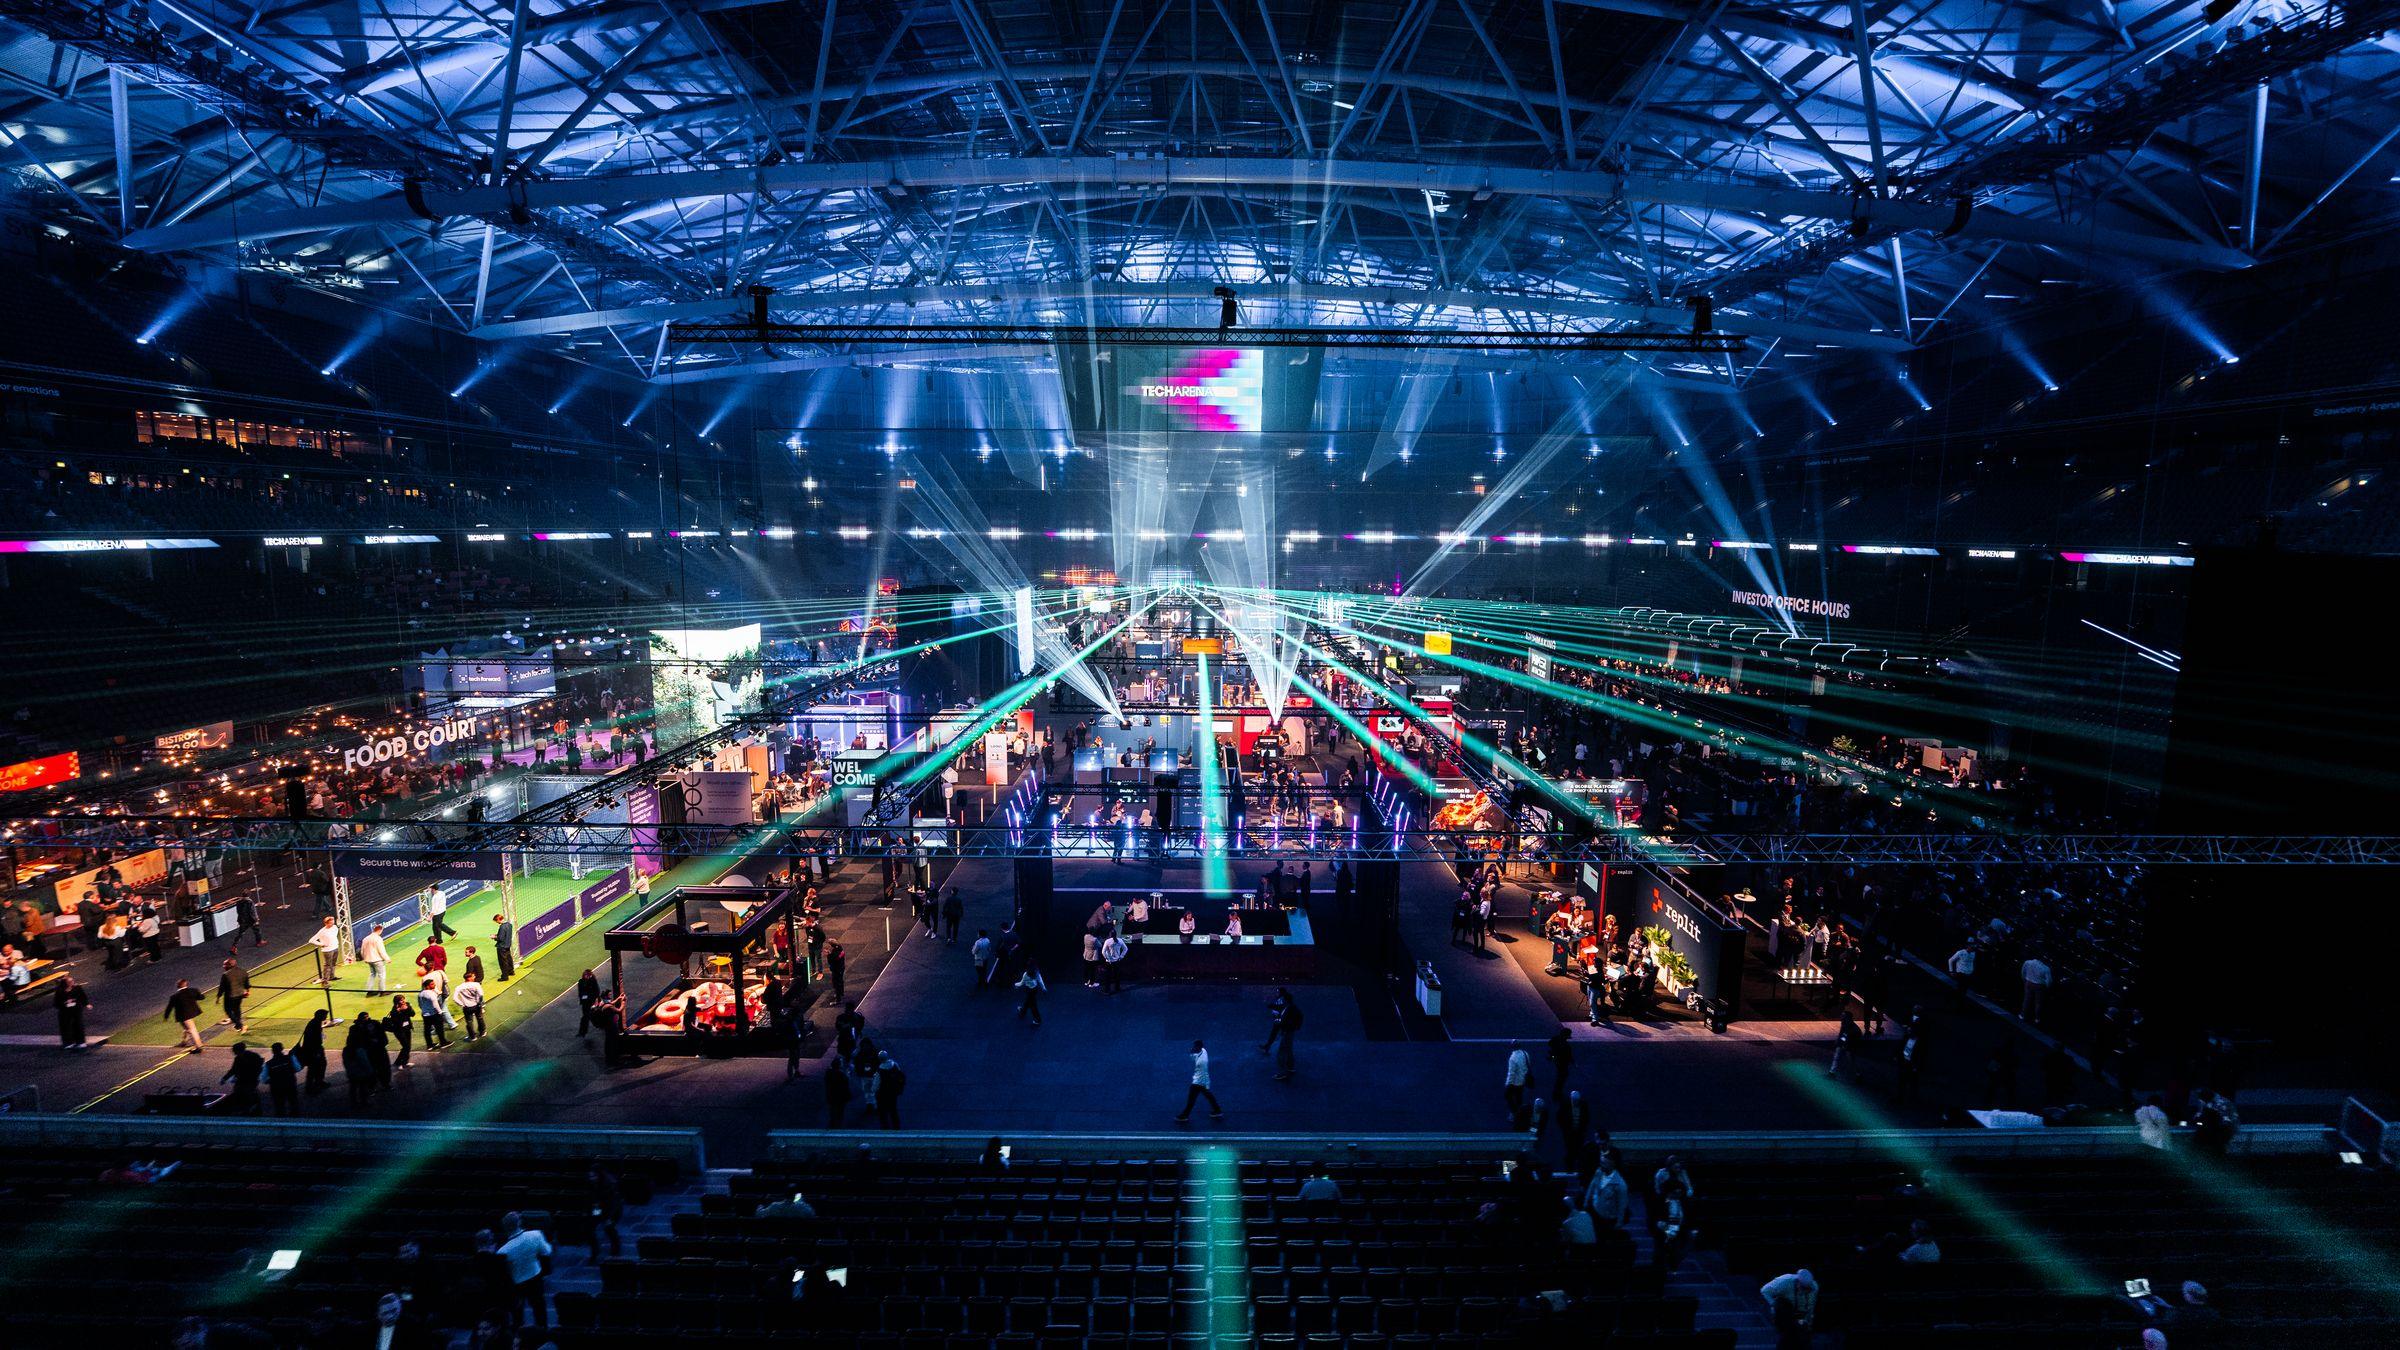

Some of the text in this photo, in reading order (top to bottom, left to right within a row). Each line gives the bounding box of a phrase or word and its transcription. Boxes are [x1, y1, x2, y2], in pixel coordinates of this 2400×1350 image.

[1141, 385, 1214, 397] TECHARENA
[264, 537, 309, 546] TECHARENA
[1732, 590, 1851, 619] INVESTOR OFFICE HOURS
[158, 732, 191, 747] BISTRO
[344, 717, 477, 771] FOOD COURT
[832, 761, 862, 773] WEL
[833, 773, 876, 785] COME
[360, 857, 391, 867] Secure
[393, 858, 408, 867] the
[1665, 903, 1701, 943] replit
